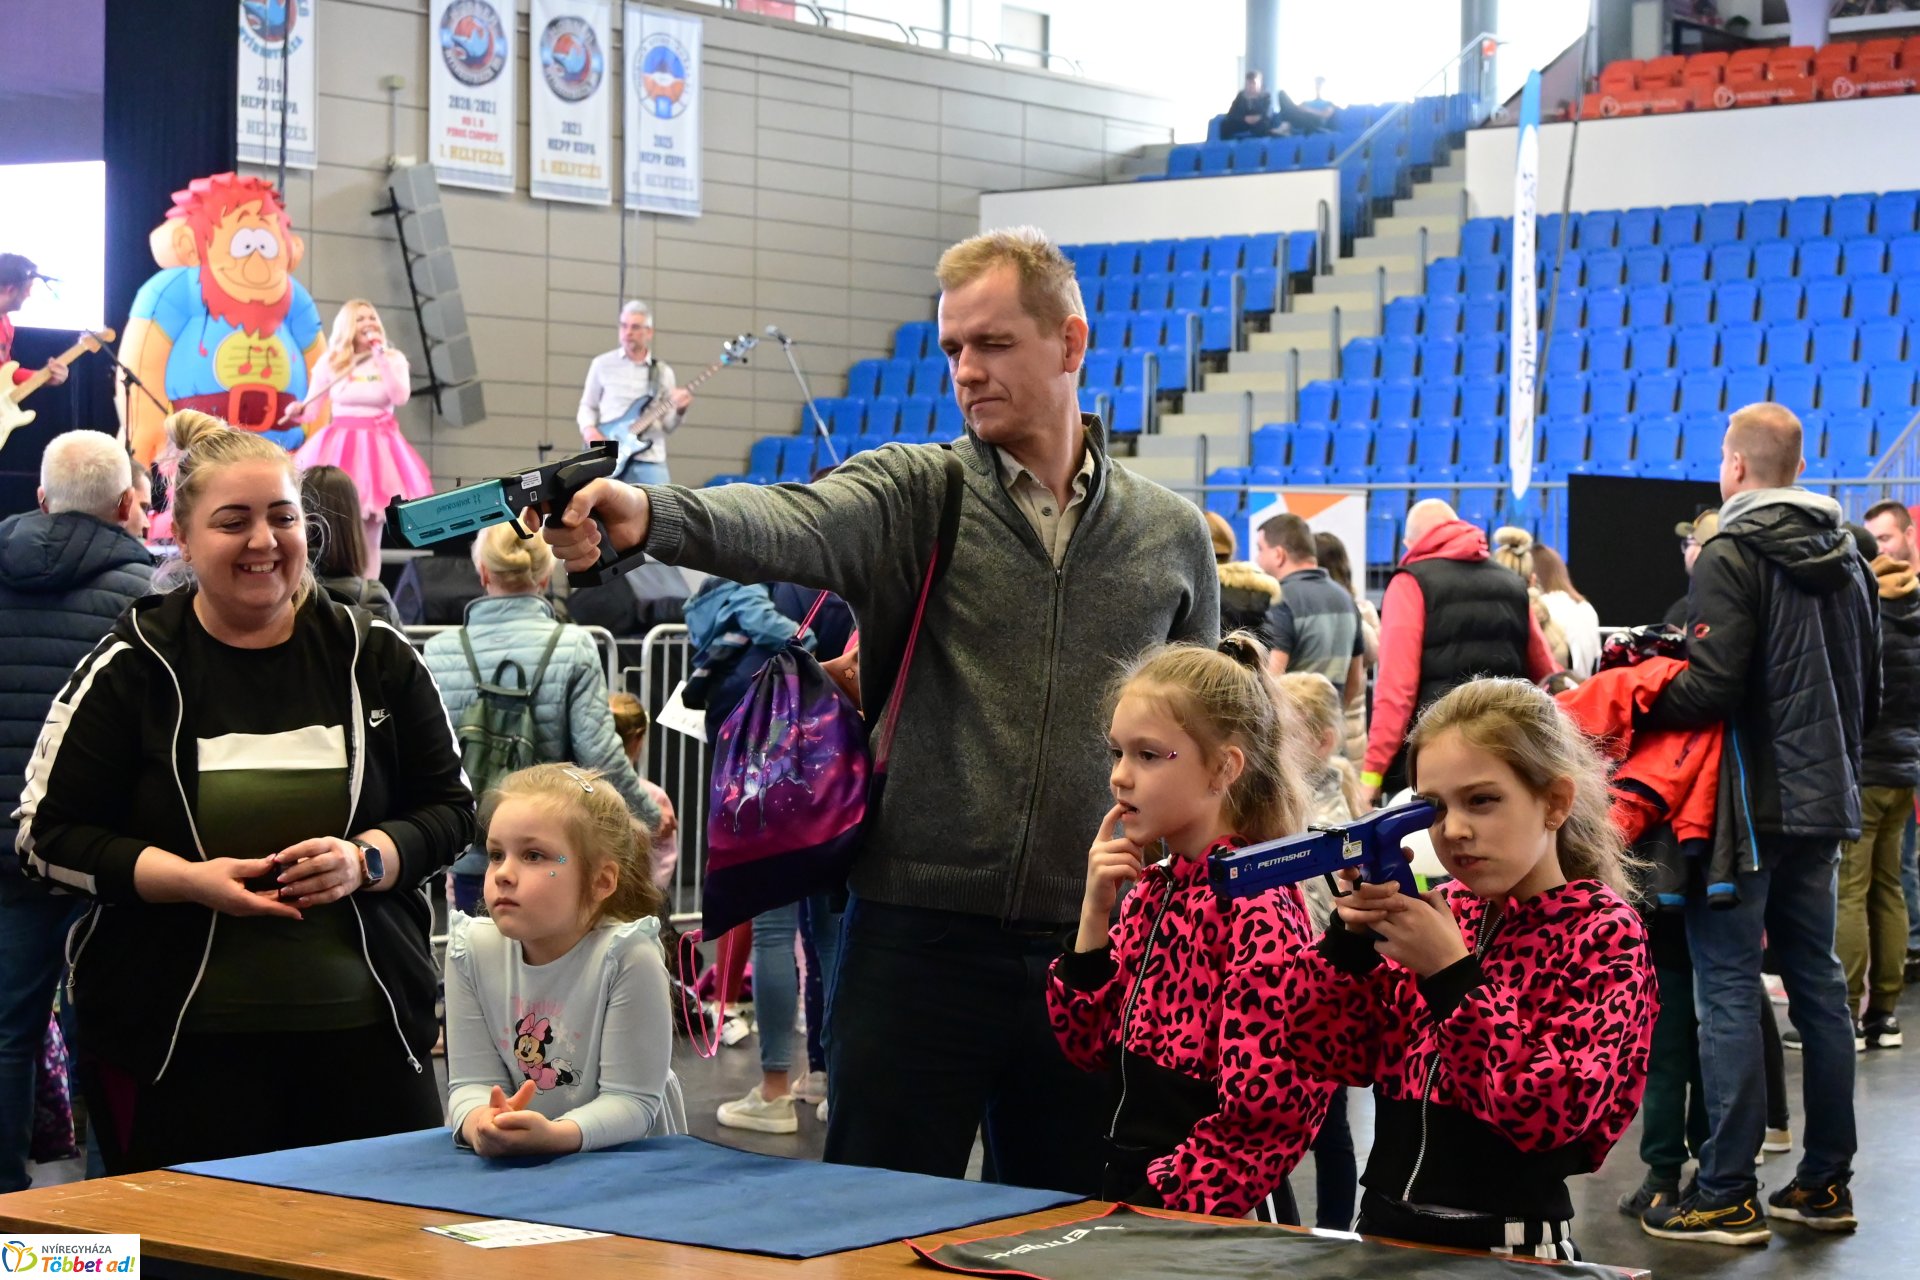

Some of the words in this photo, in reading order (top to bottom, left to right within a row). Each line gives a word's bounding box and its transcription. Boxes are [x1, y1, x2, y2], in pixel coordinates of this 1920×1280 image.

[240, 95, 267, 111] HEPP
[448, 94, 497, 115] 2020/2021
[246, 119, 308, 141] HELYZÉS
[1257, 849, 1312, 869] PENTASHOT
